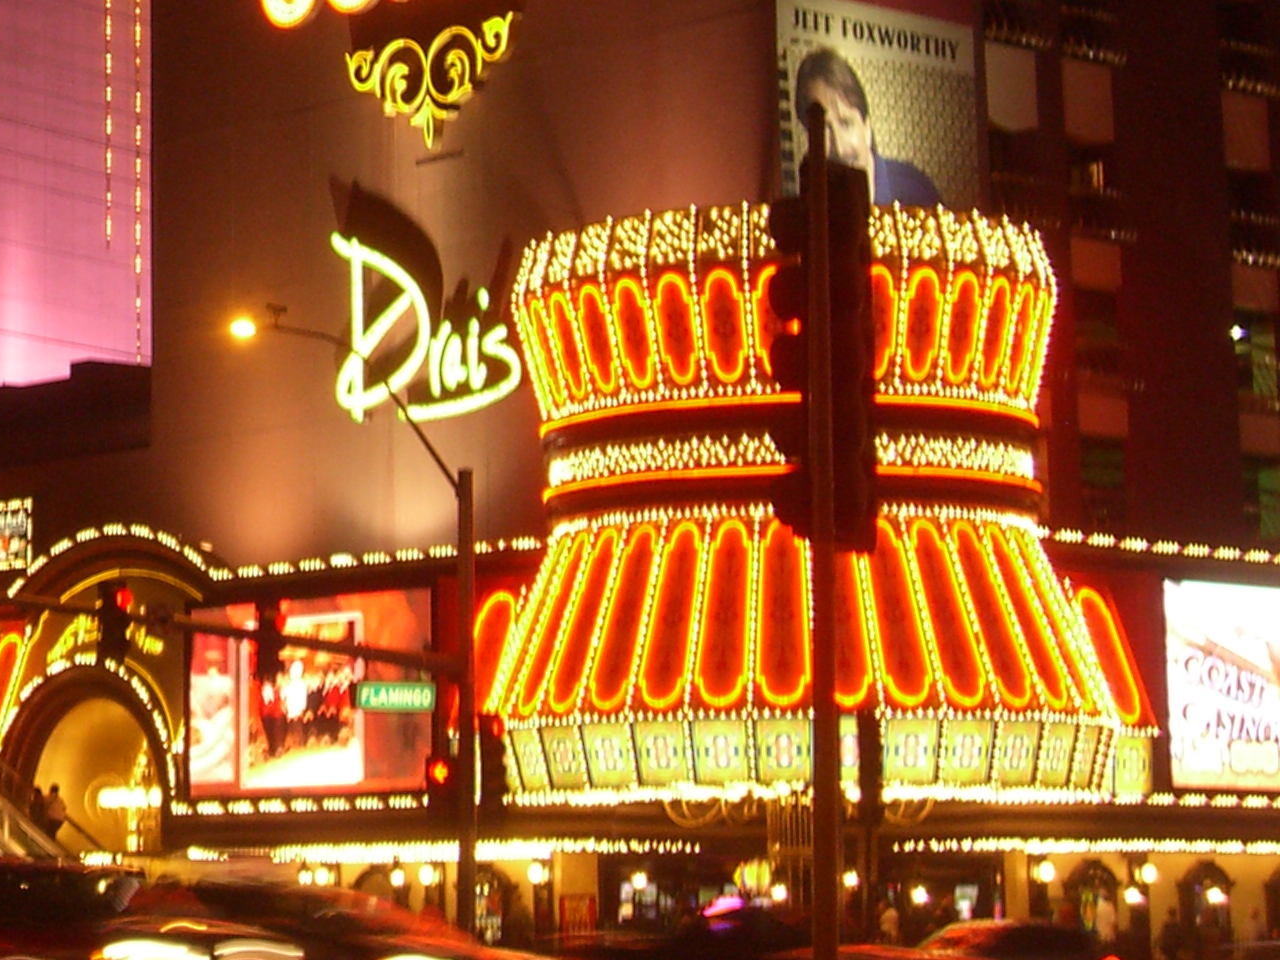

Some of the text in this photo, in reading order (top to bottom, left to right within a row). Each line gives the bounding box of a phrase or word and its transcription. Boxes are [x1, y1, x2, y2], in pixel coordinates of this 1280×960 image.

[793, 6, 960, 61] JEFF FOXWORTHY
[361, 686, 431, 708] FLAMINGO
[1177, 647, 1267, 709] COAST
